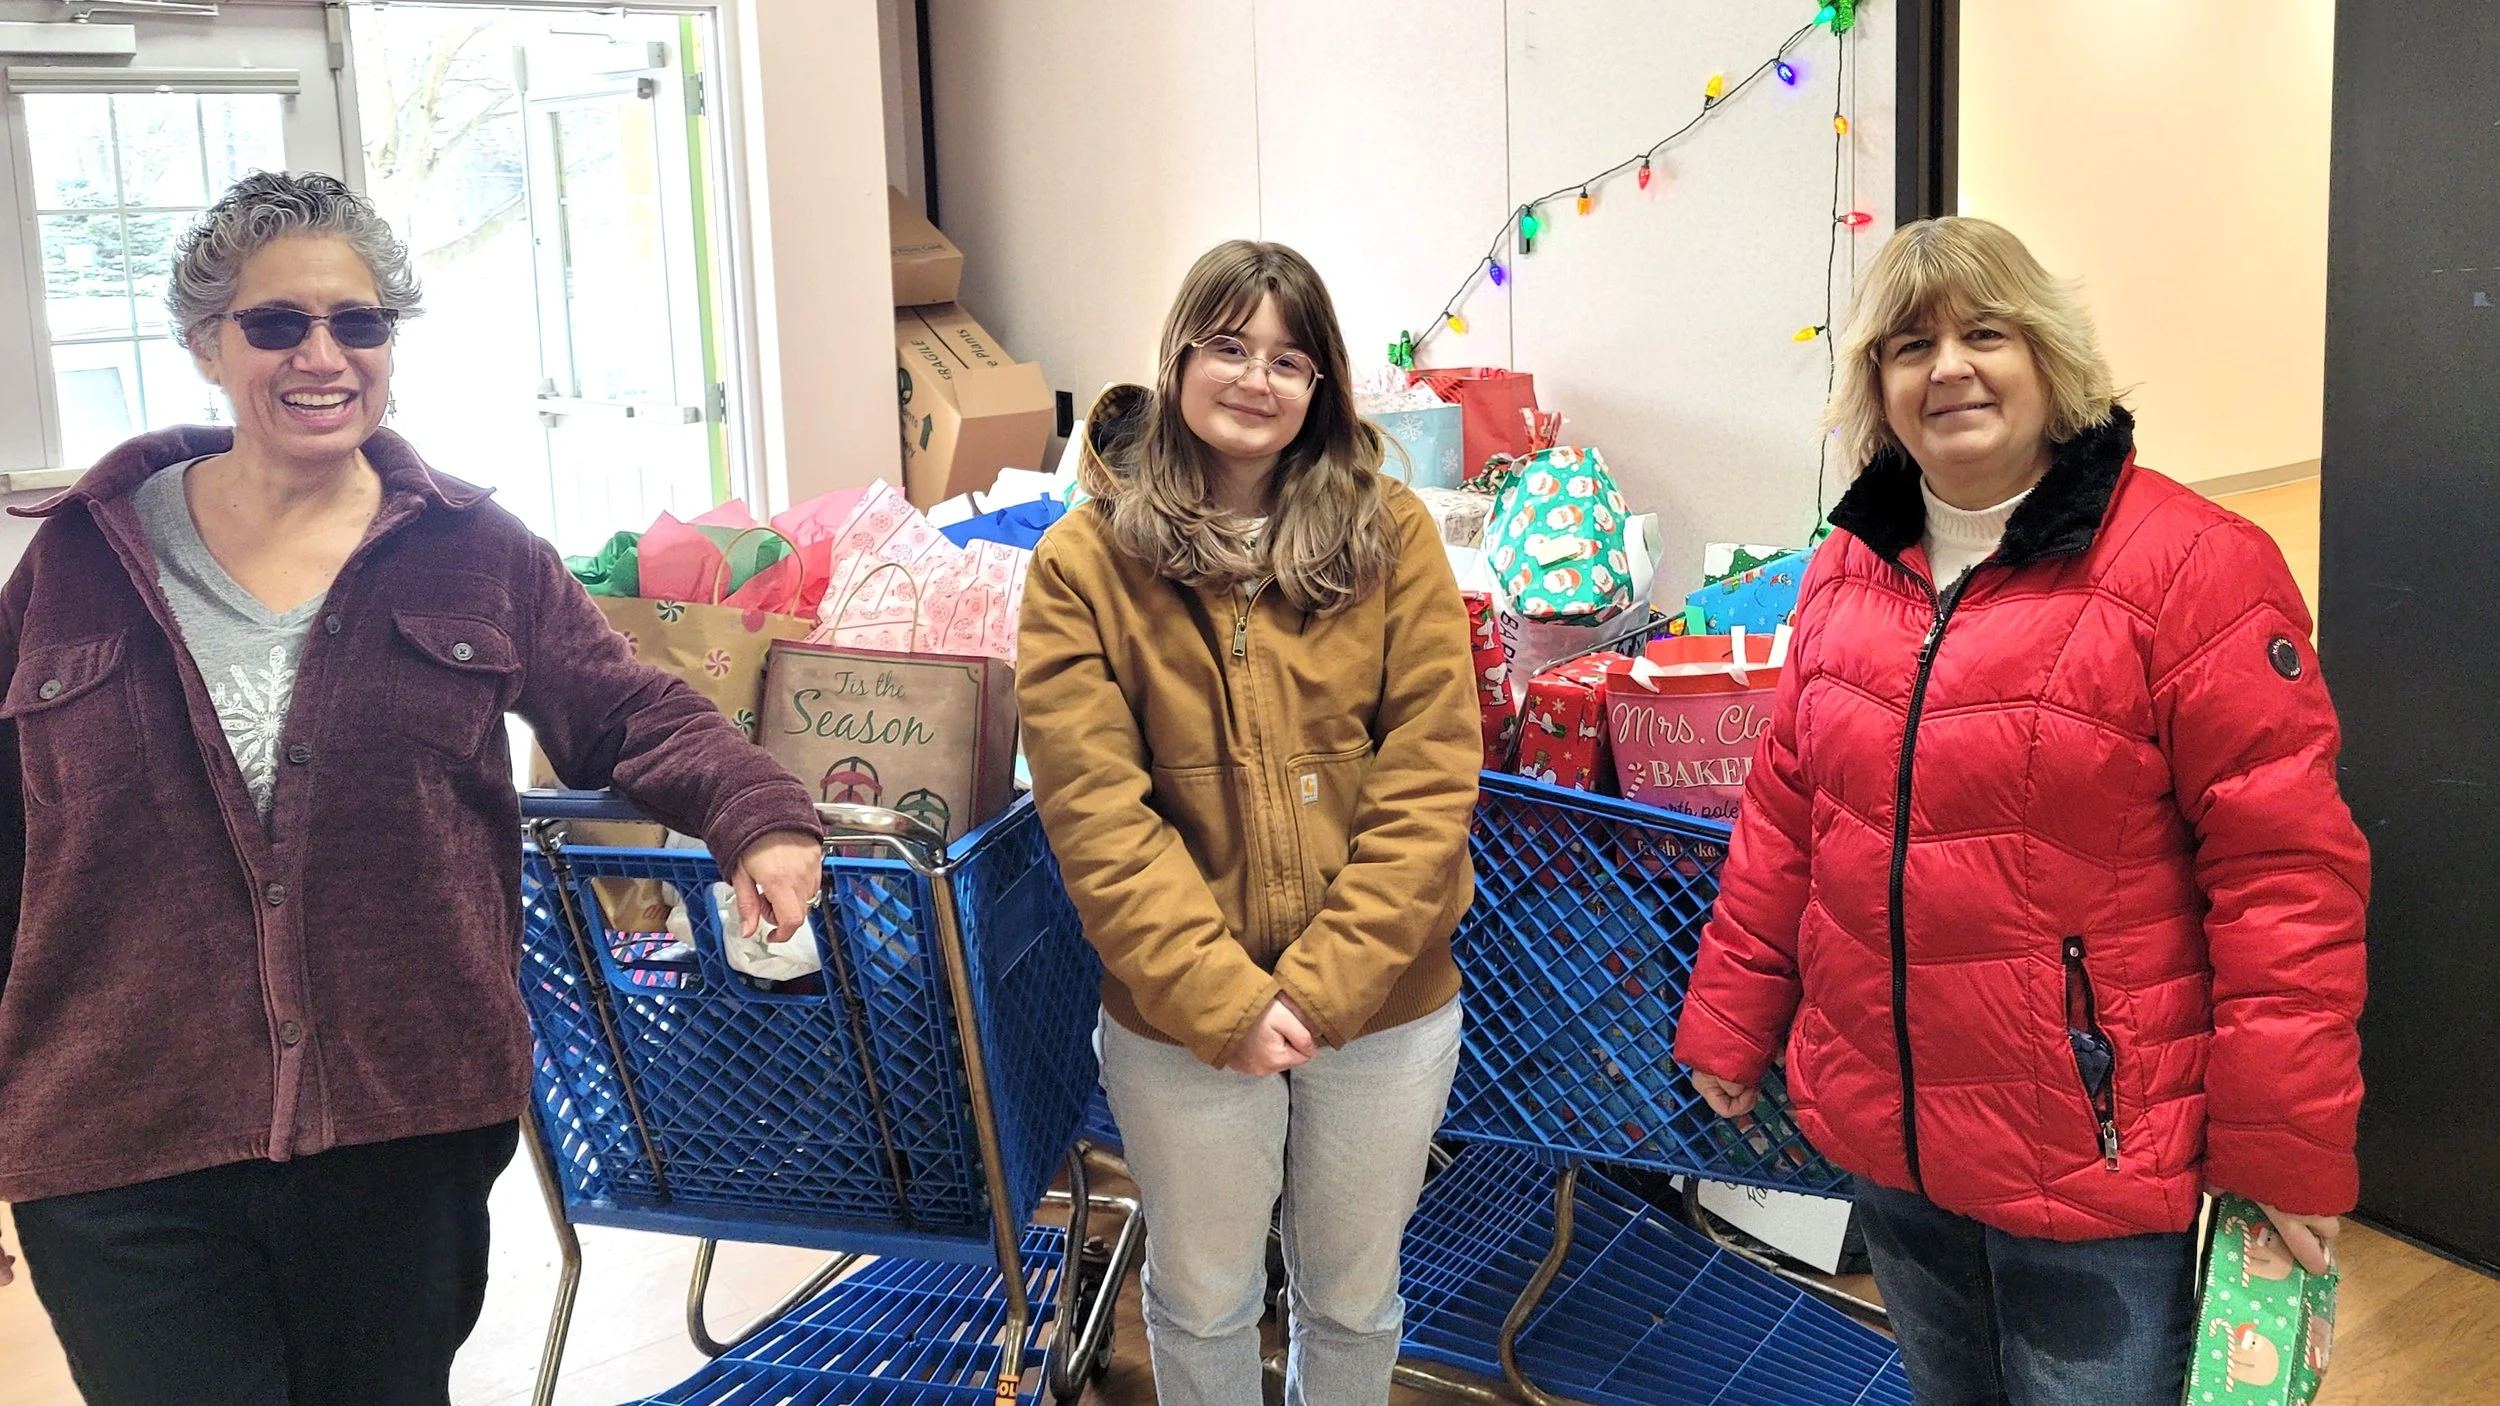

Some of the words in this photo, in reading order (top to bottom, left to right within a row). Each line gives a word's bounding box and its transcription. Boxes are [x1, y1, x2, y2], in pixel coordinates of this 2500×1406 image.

[910, 339, 953, 381] FRAGILE
[956, 328, 991, 359] Plants
[835, 671, 869, 697] Tis
[875, 670, 906, 698] the
[784, 688, 934, 746] Season
[1611, 702, 1706, 747] Mrs.
